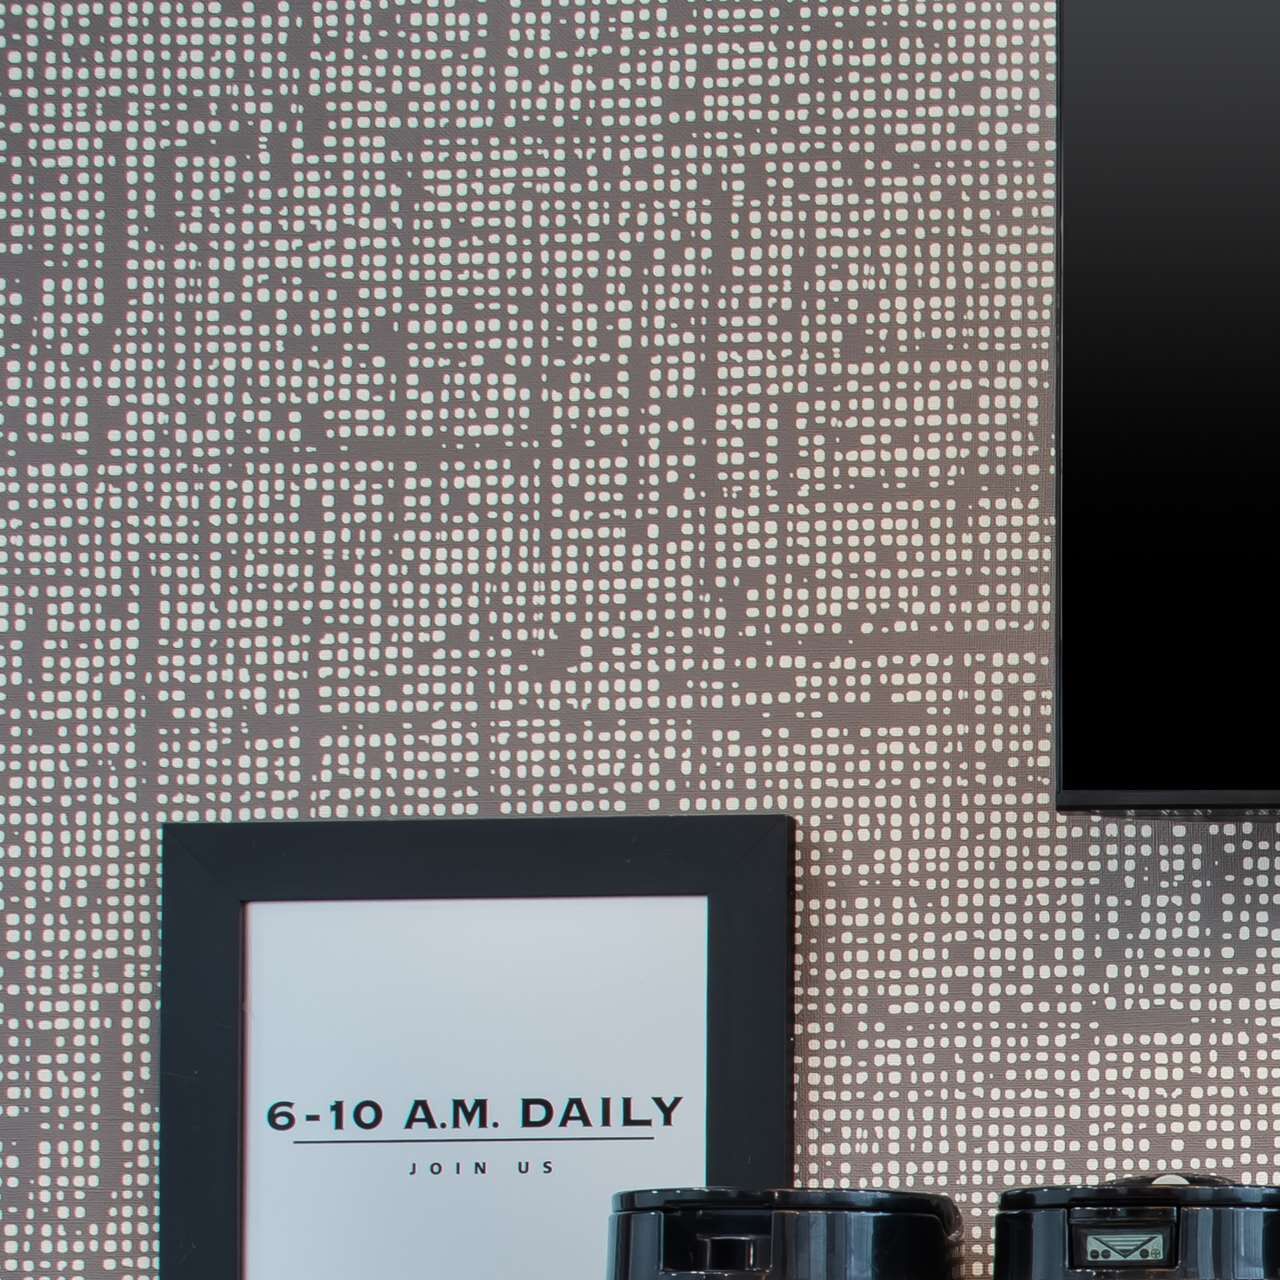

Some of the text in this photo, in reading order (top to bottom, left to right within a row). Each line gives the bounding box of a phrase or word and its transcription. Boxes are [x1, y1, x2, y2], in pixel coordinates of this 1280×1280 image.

[267, 1096, 684, 1131] 6-10 A.M. DAILY
[409, 1160, 555, 1176] JOIN US
